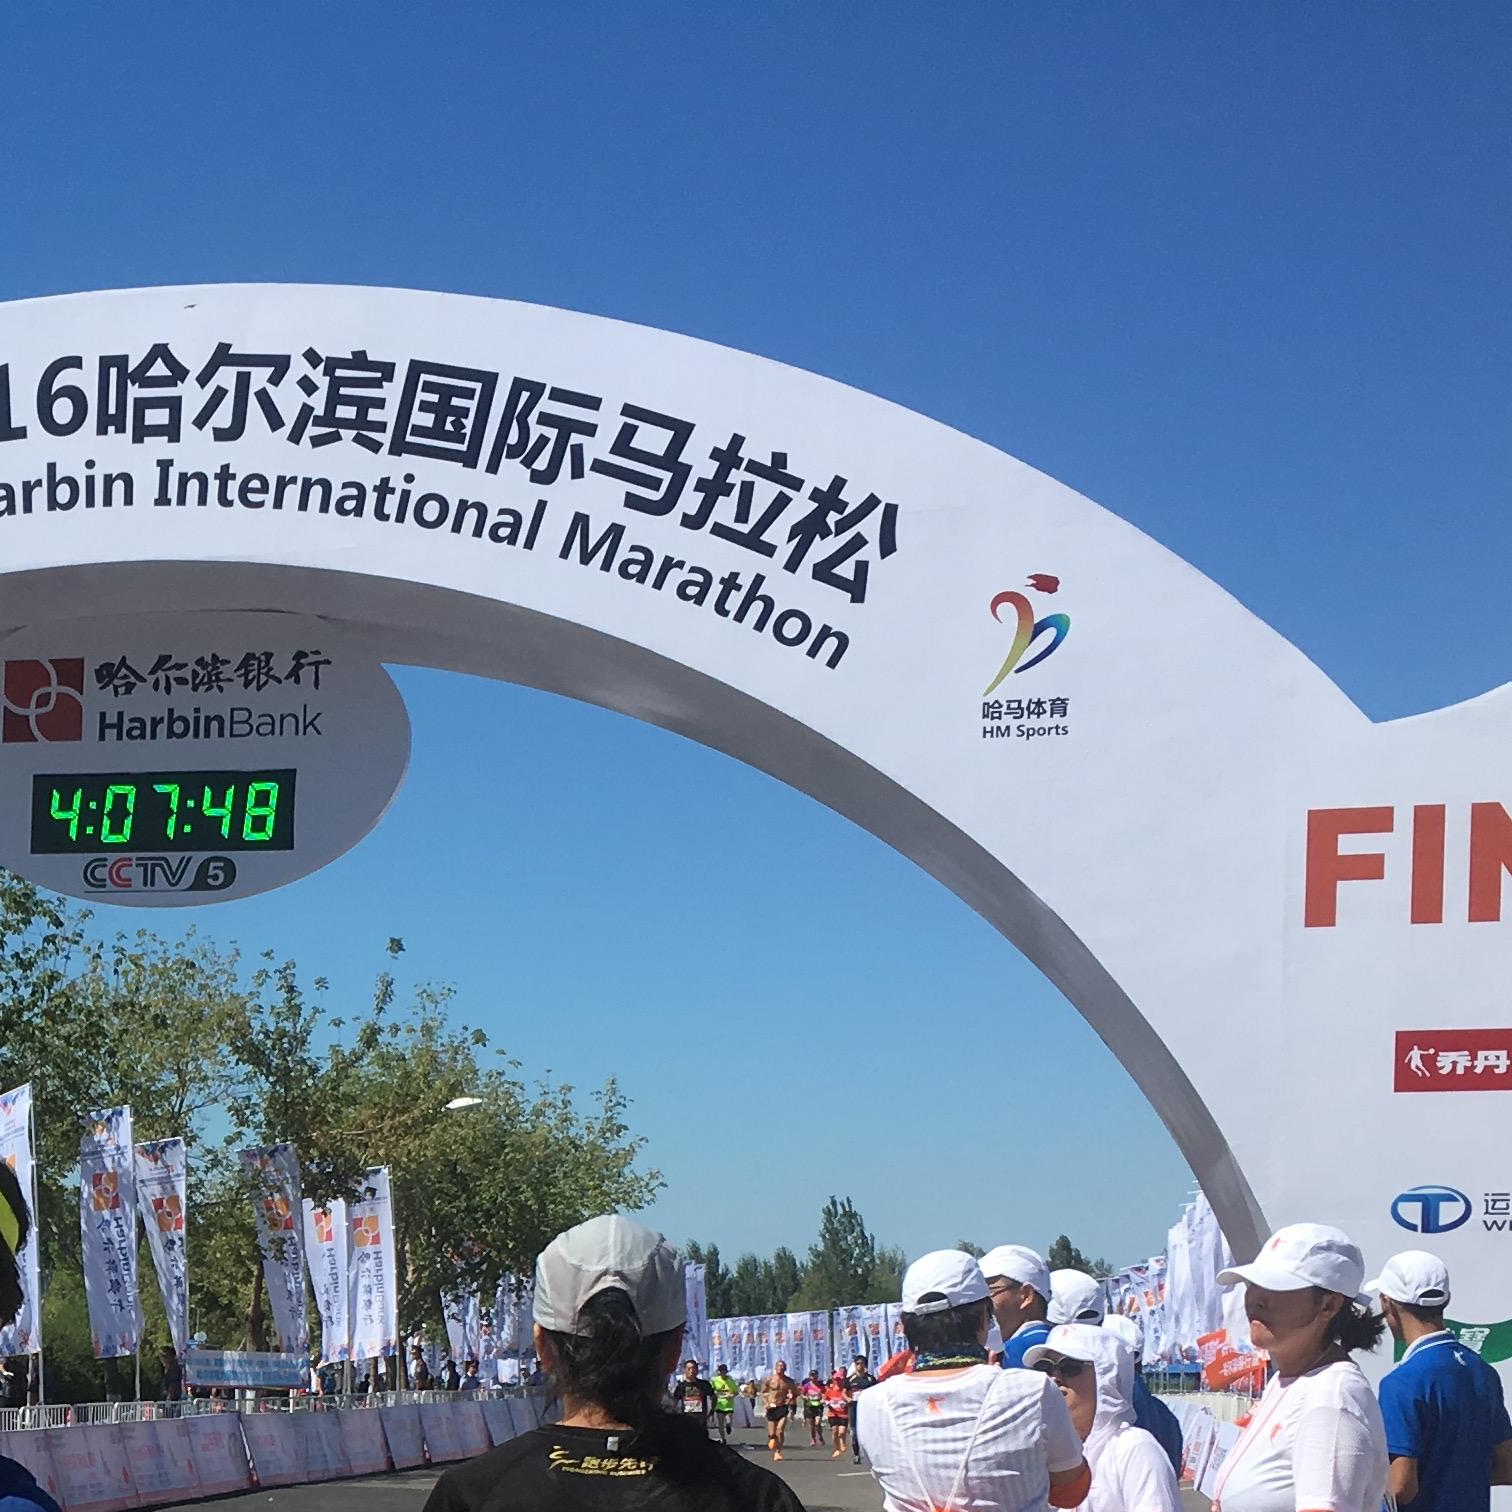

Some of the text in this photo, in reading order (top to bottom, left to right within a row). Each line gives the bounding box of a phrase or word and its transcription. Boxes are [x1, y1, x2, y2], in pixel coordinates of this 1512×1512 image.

[153, 459, 547, 551] International
[558, 512, 850, 671] Marathon
[94, 649, 333, 698] 哈尔滨银行
[98, 704, 324, 742] HarbinBank
[982, 697, 1070, 721] 哈马体育
[982, 723, 1069, 741] HM Sports
[50, 782, 280, 844] 4:07:48
